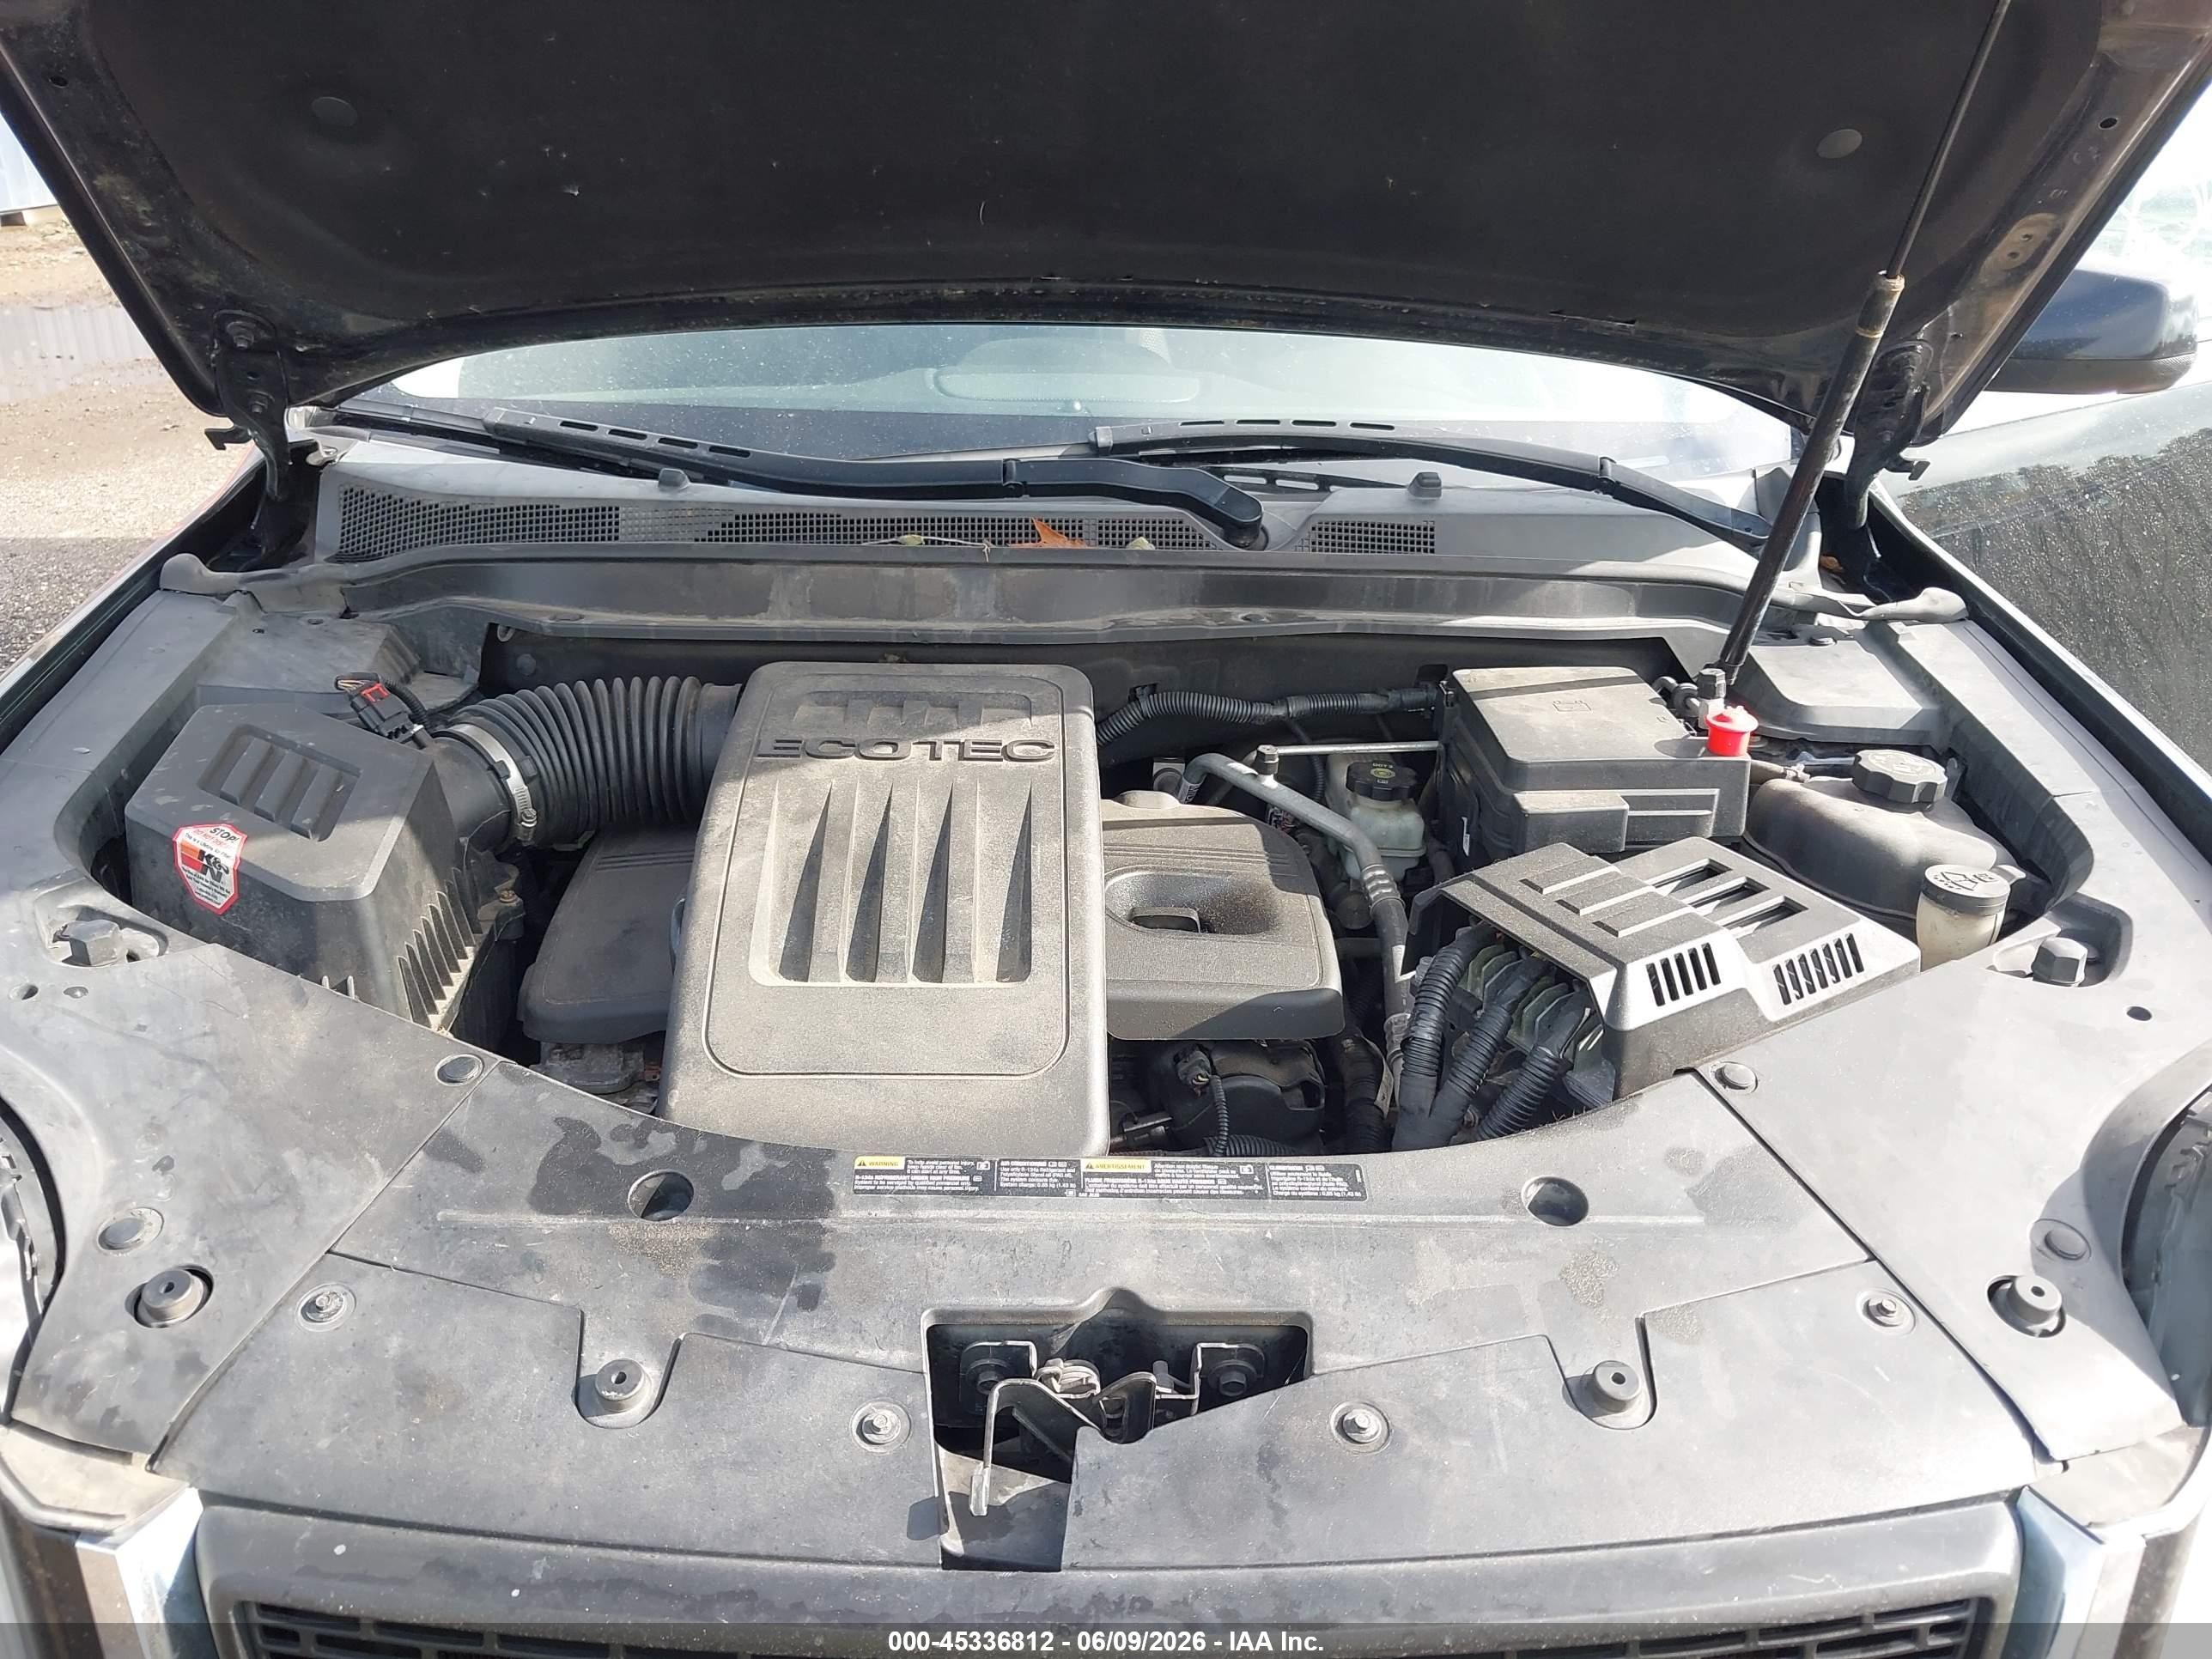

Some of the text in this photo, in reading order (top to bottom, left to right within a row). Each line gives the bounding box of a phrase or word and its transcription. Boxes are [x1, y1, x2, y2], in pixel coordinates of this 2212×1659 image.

[757, 738, 1055, 763] ECOTEC
[210, 827, 240, 843] STOP!
[198, 849, 229, 884] K&N
